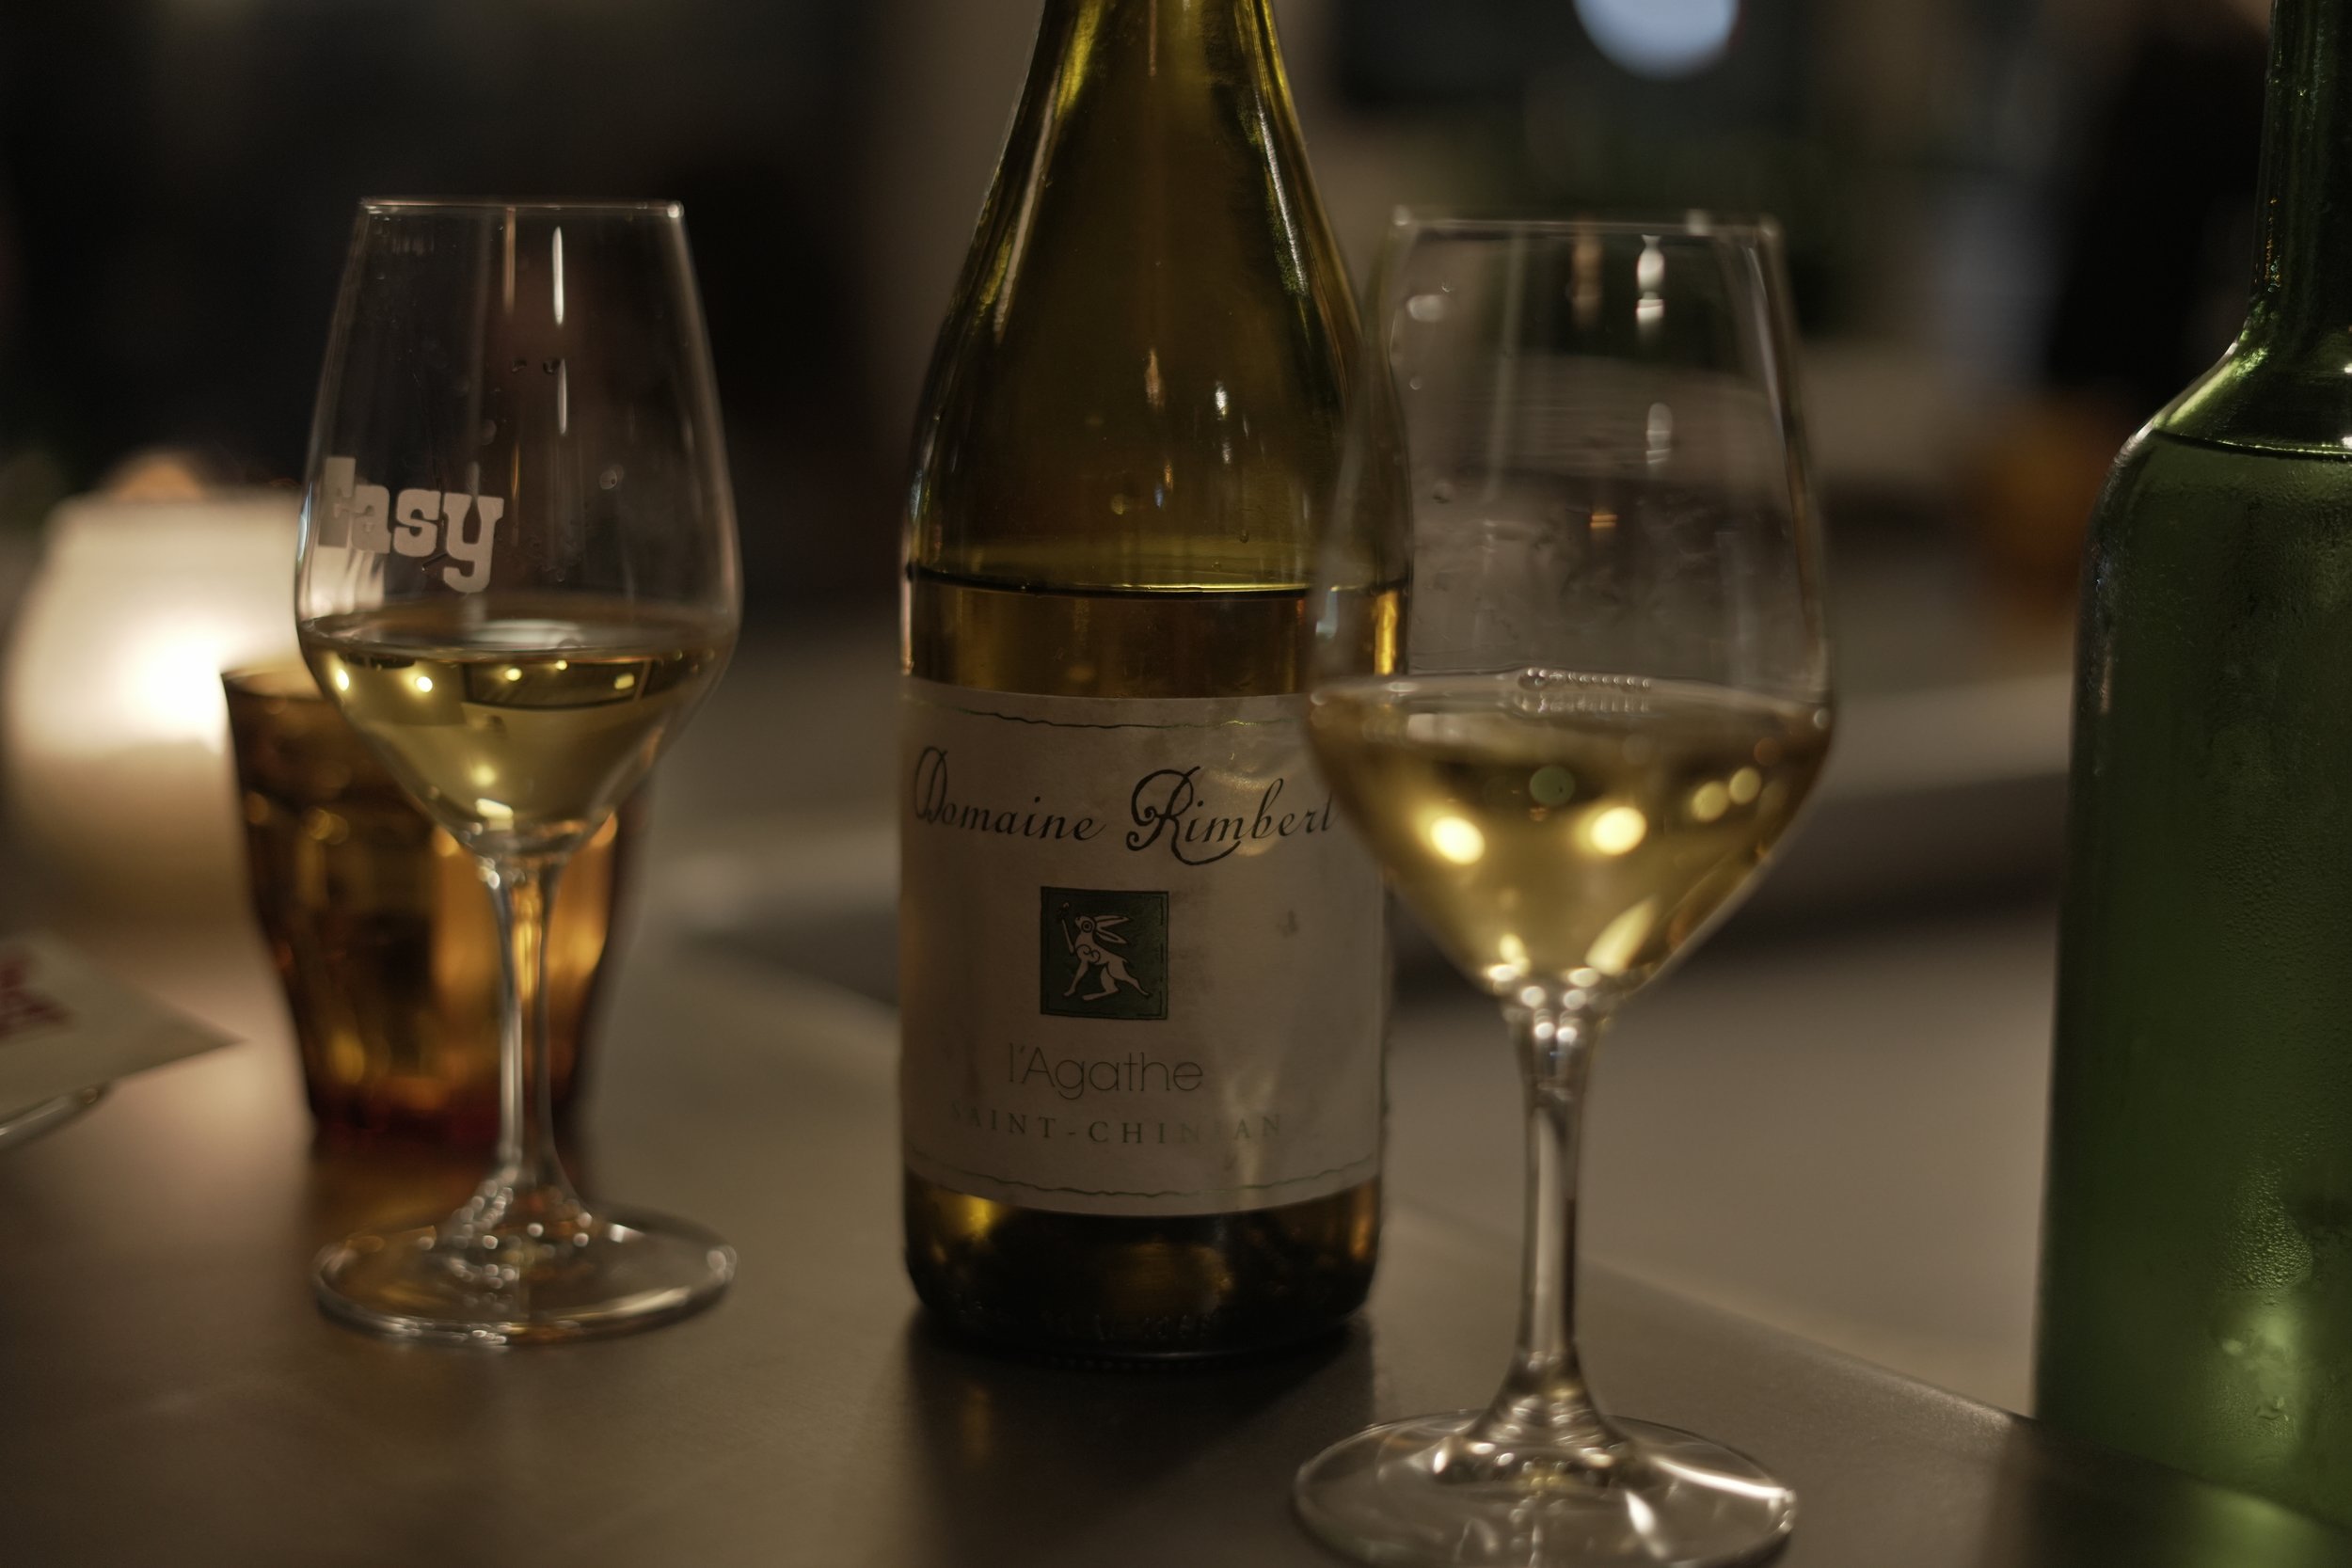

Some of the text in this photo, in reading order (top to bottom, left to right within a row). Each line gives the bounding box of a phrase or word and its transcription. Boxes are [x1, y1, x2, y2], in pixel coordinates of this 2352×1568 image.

[914, 746, 1106, 841] Domaine
[1009, 1041, 1203, 1100] l'Agathe
[950, 1101, 1281, 1145] SAINT-CHINAN
